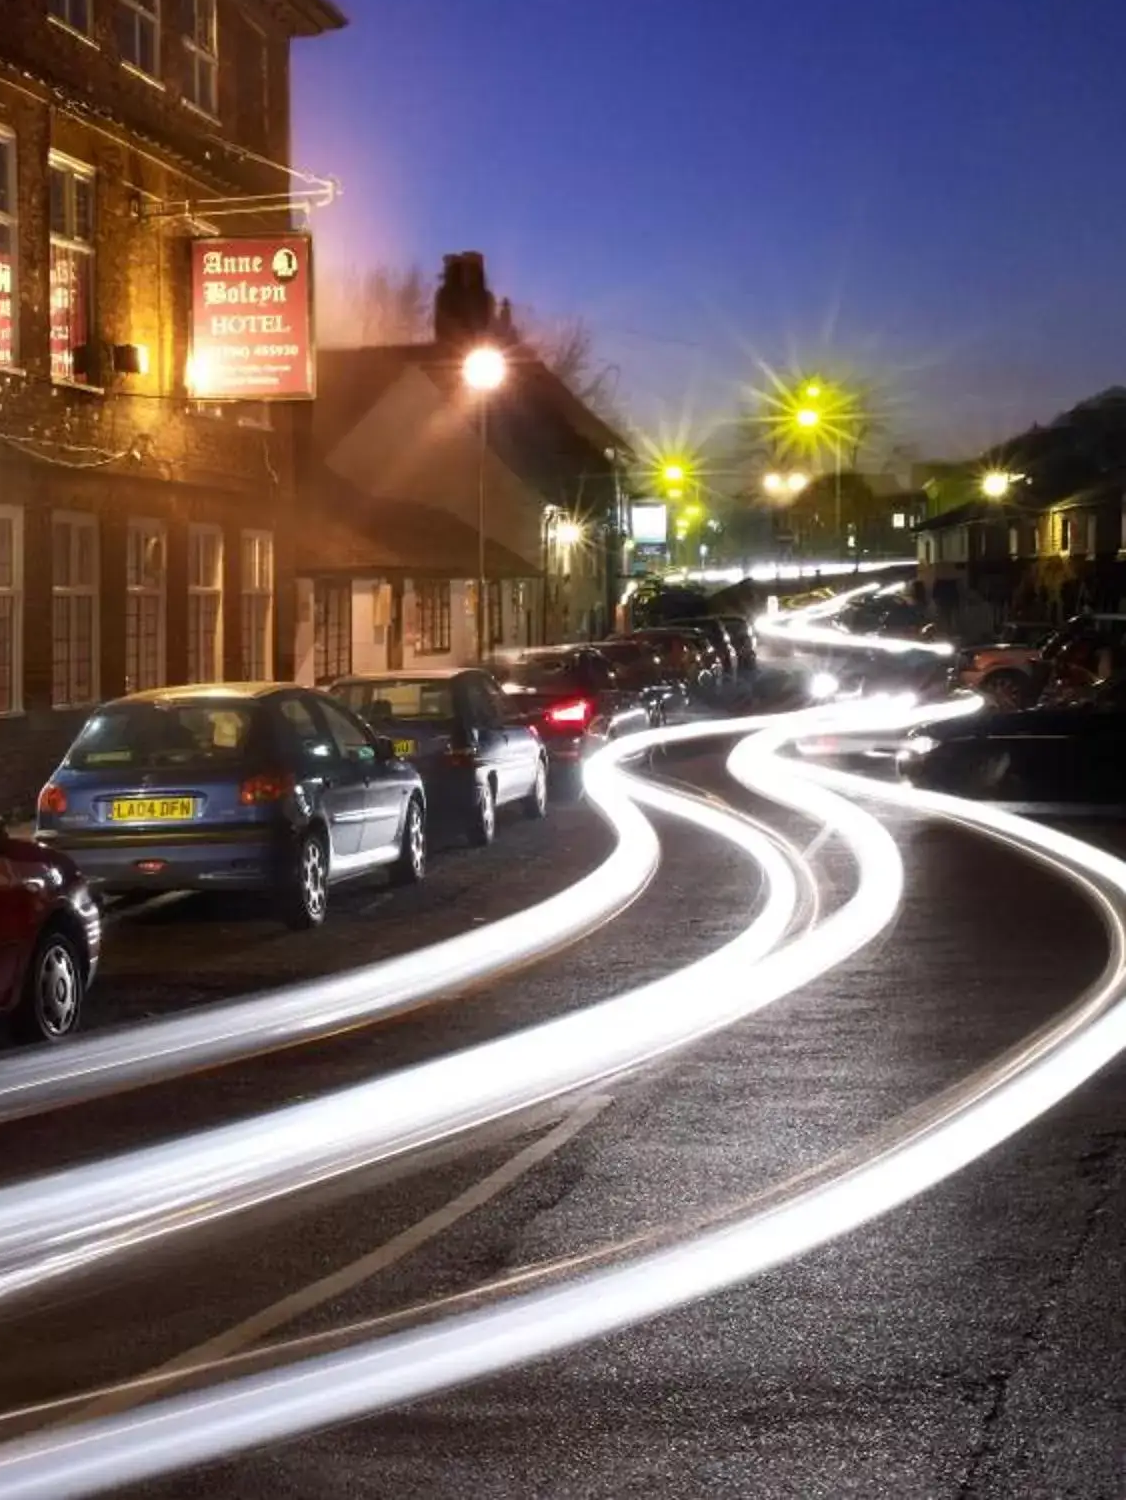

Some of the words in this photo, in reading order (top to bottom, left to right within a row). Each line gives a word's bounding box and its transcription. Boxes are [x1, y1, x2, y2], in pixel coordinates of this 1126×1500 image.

[202, 251, 263, 275] Anne
[203, 281, 287, 309] Boleyn
[211, 315, 291, 336] HOTEL
